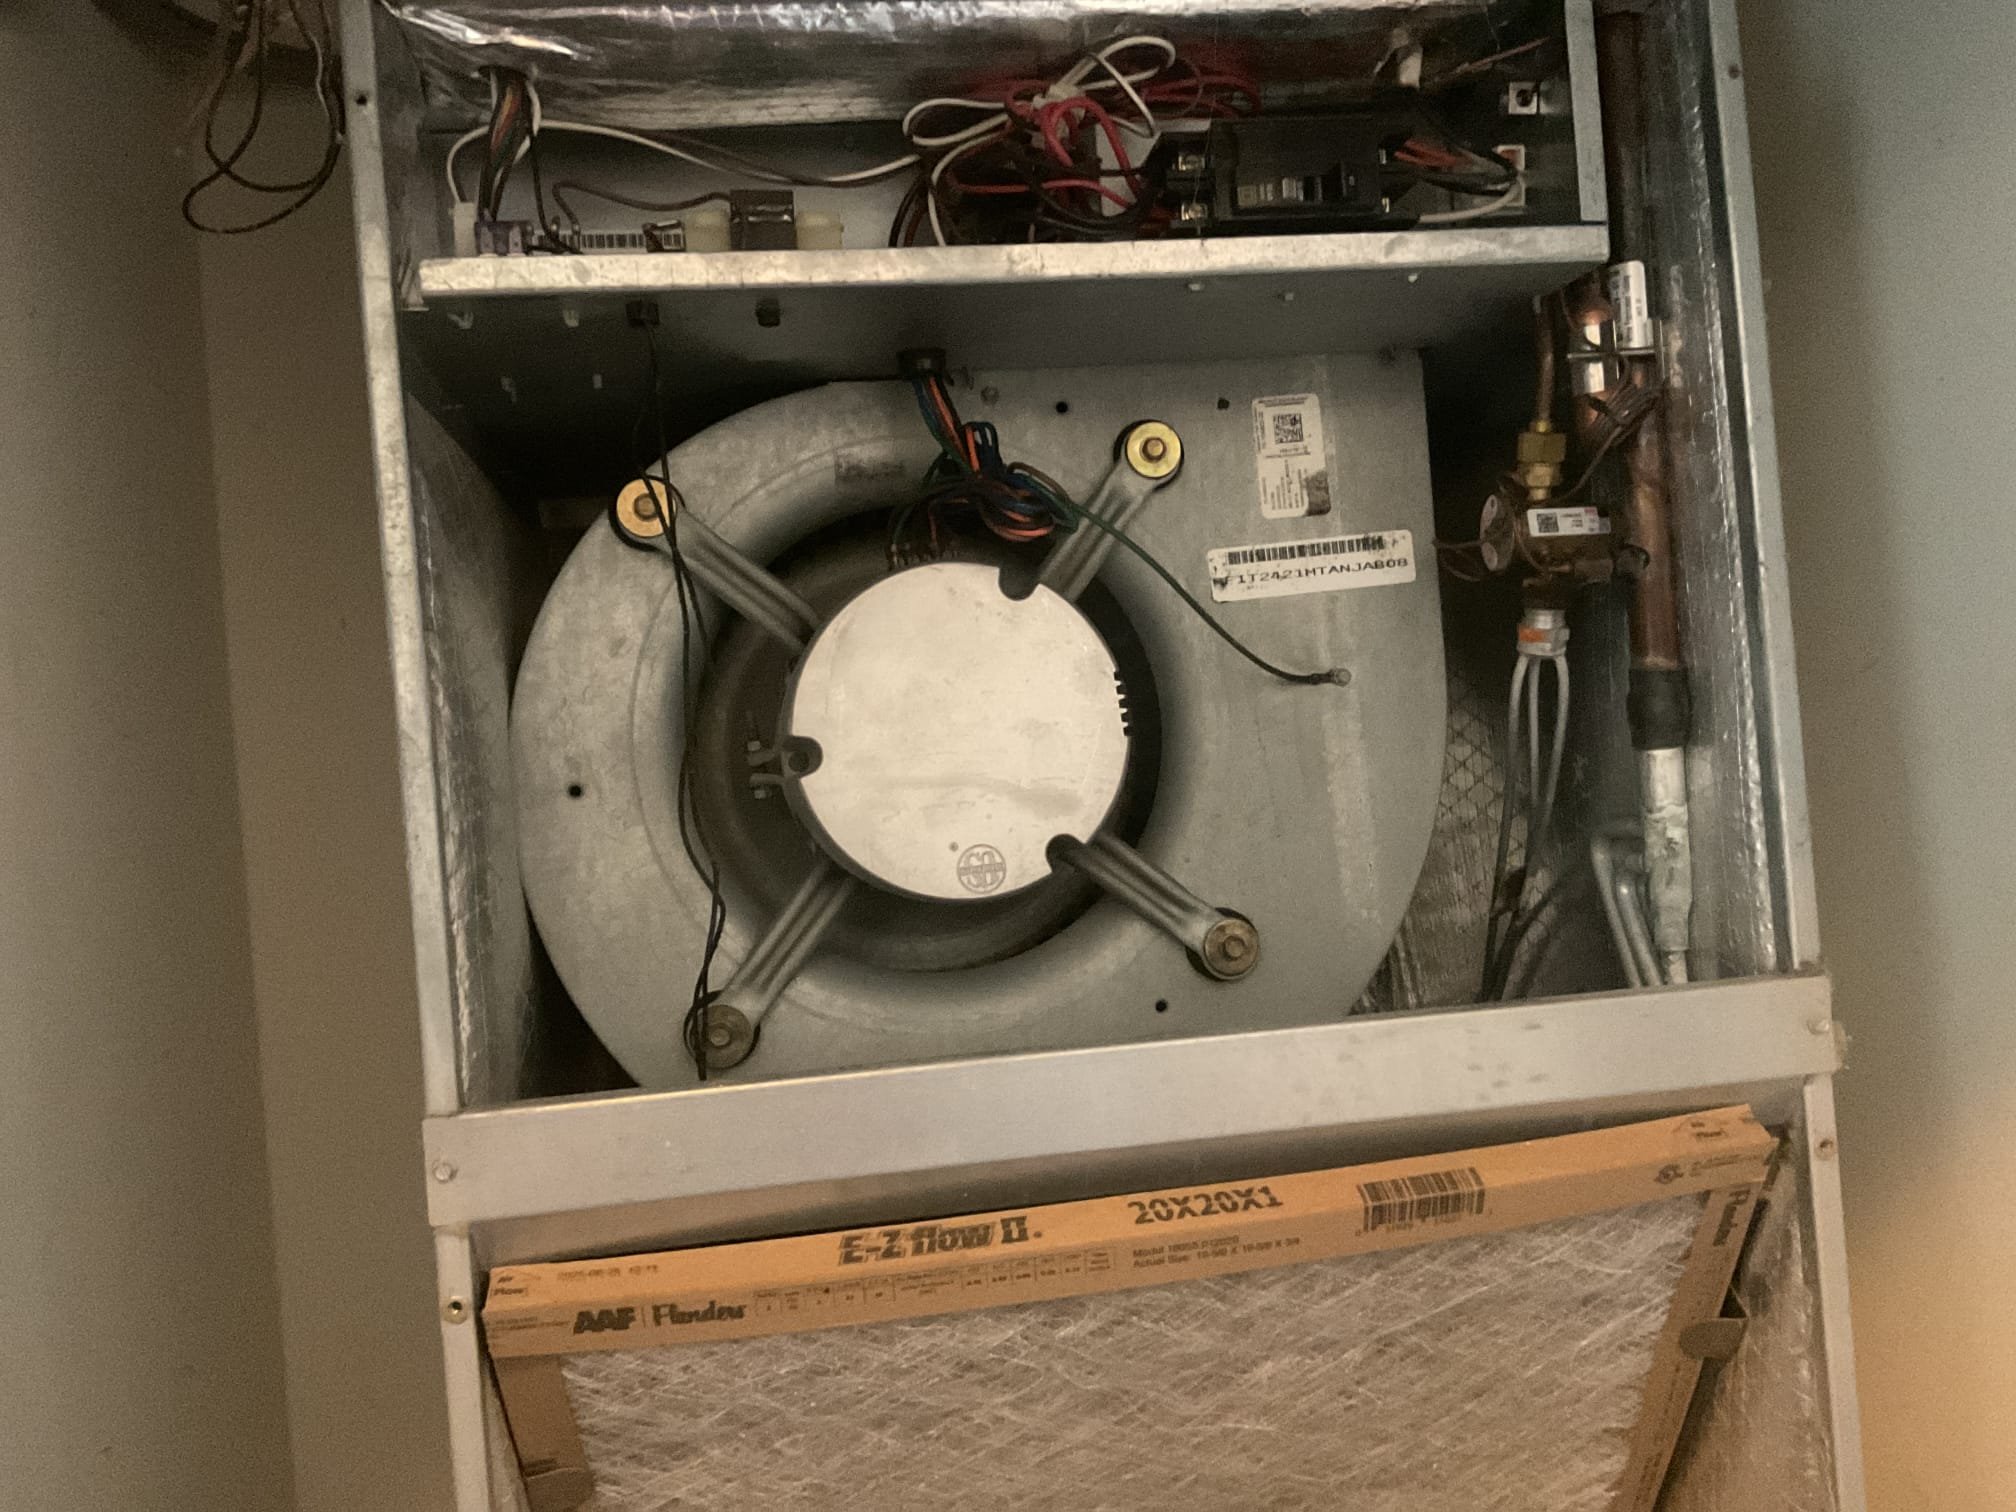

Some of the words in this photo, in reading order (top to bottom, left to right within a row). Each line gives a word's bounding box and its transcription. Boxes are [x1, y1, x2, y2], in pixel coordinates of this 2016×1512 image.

[1128, 1185, 1283, 1225] 20X20X1
[838, 1228, 907, 1266] E-Z
[573, 1305, 637, 1335] AAF
